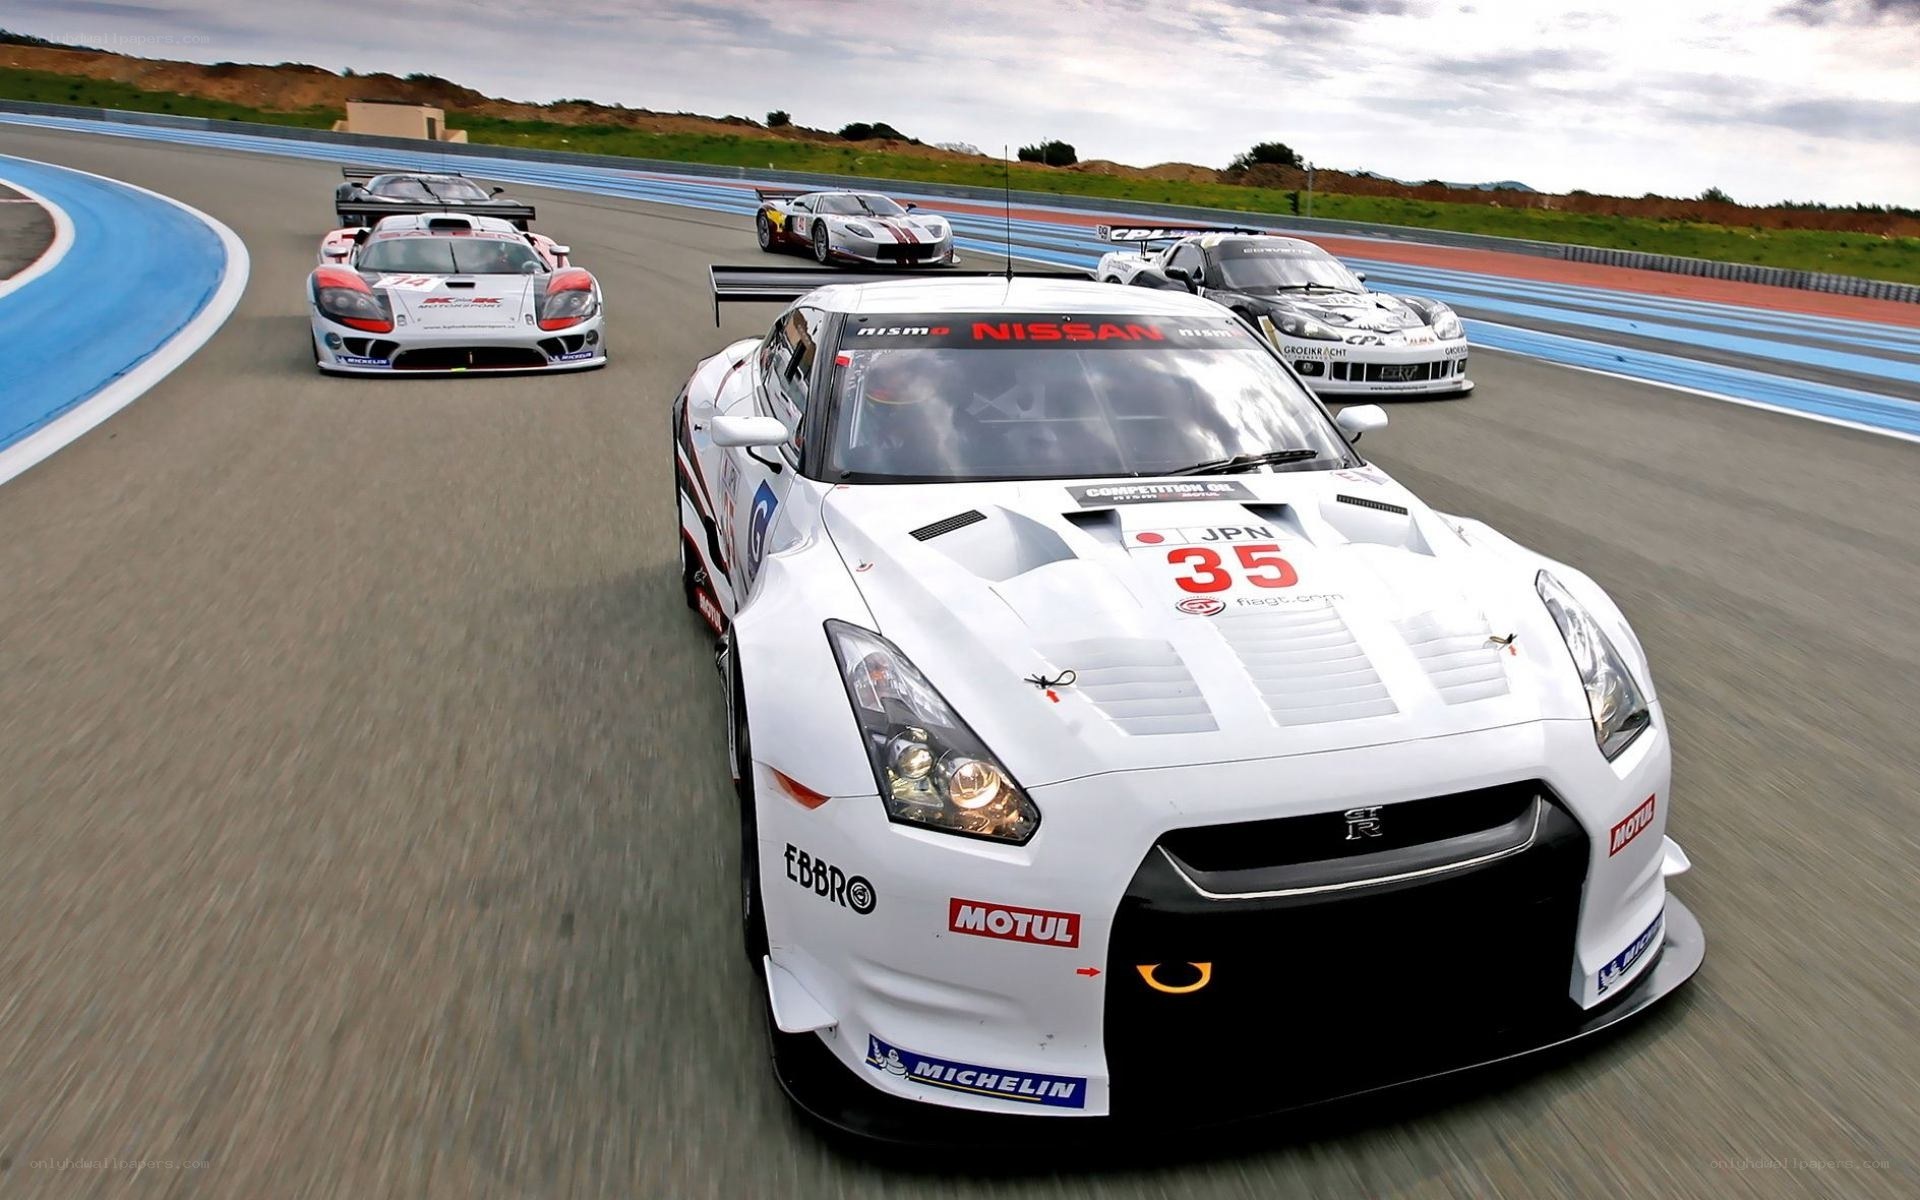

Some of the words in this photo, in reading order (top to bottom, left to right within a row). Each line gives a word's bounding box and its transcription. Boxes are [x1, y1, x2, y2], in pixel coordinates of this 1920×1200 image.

[857, 327, 950, 336] nismo
[971, 321, 1165, 341] NISSAN
[1284, 346, 1347, 357] GROEIKRACHT
[1086, 484, 1204, 498] COMPETITION
[1206, 483, 1235, 491] OIL
[1201, 527, 1275, 542] JPN
[1167, 544, 1299, 594] 35
[1612, 801, 1654, 851] MOTUL
[784, 842, 877, 915] EBBRO
[954, 905, 1073, 942] MOTUL
[913, 1060, 1076, 1098] MICHELIN
